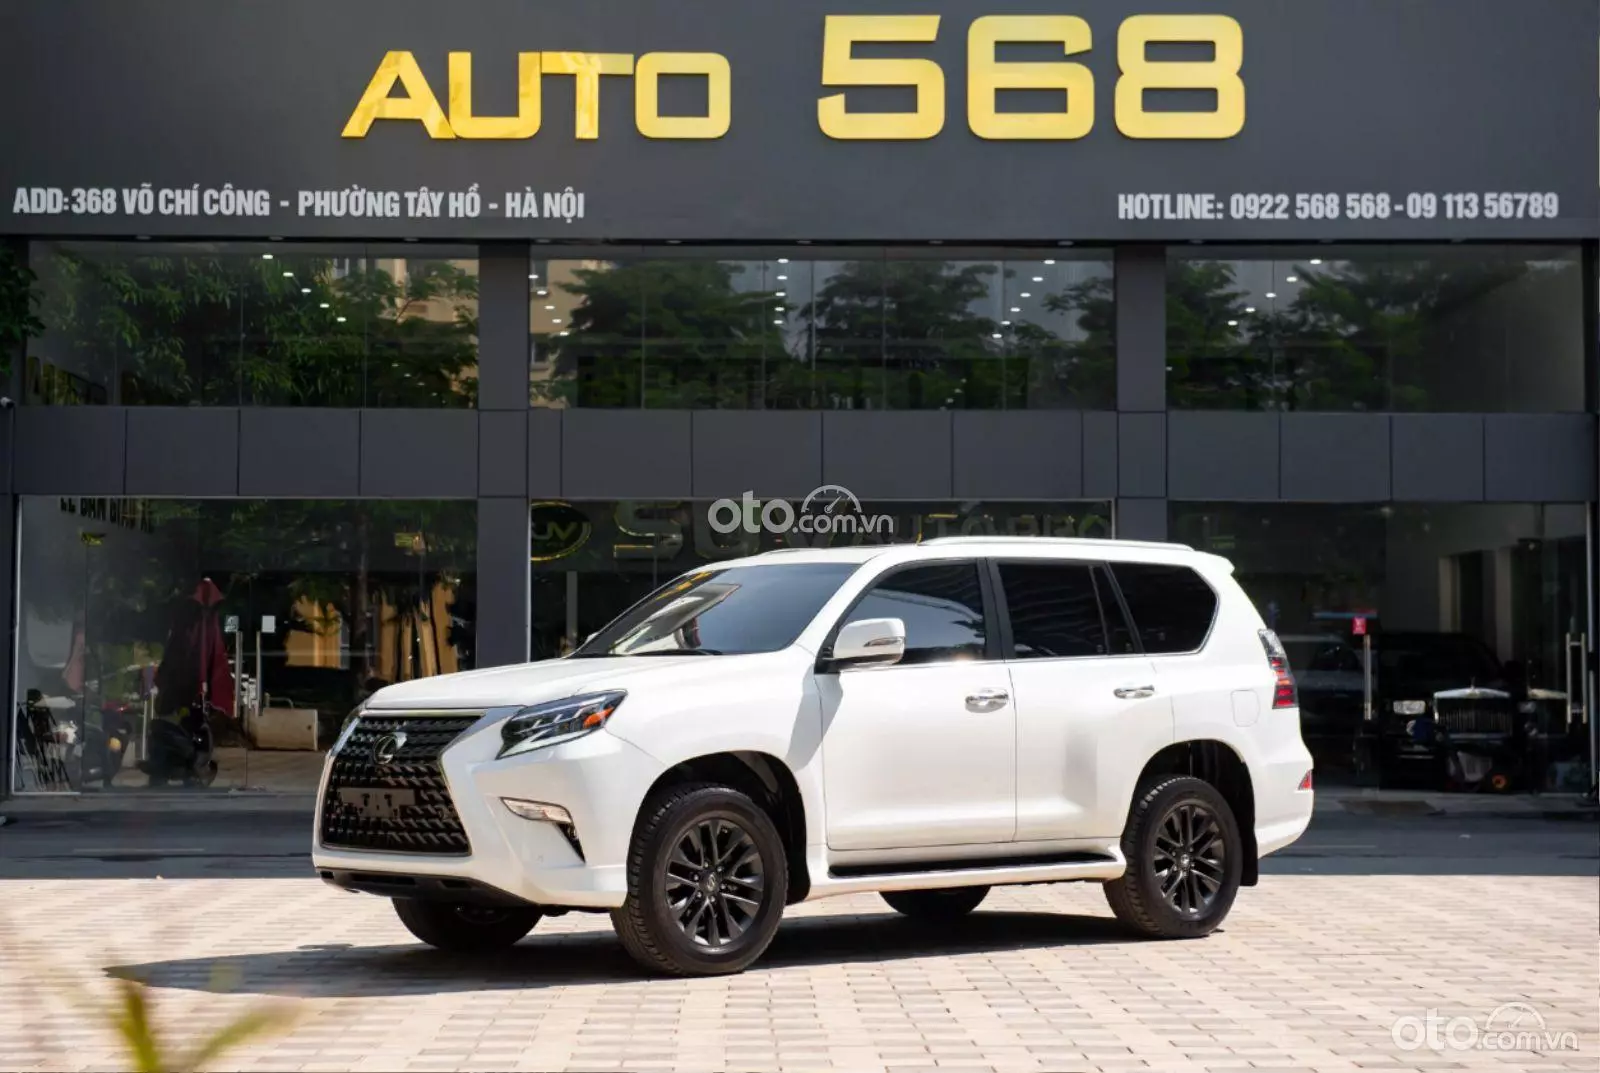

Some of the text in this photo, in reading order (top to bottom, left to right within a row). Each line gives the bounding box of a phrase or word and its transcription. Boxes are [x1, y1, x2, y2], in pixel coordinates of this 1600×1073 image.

[341, 14, 1246, 139] AUTO 568
[122, 183, 154, 215] VÕ
[158, 183, 199, 215] CHÍ
[203, 183, 270, 216] CÔNG
[298, 184, 400, 217] PHƯỜNG
[404, 186, 444, 218] TÂY
[505, 186, 539, 218] HÀ
[543, 187, 584, 223] NỘI
[1118, 193, 1224, 220] HOTLINE:
[1230, 193, 1289, 220] 0922
[1295, 193, 1340, 219] 568
[1442, 192, 1479, 219] 113
[1484, 192, 1559, 219] 56789
